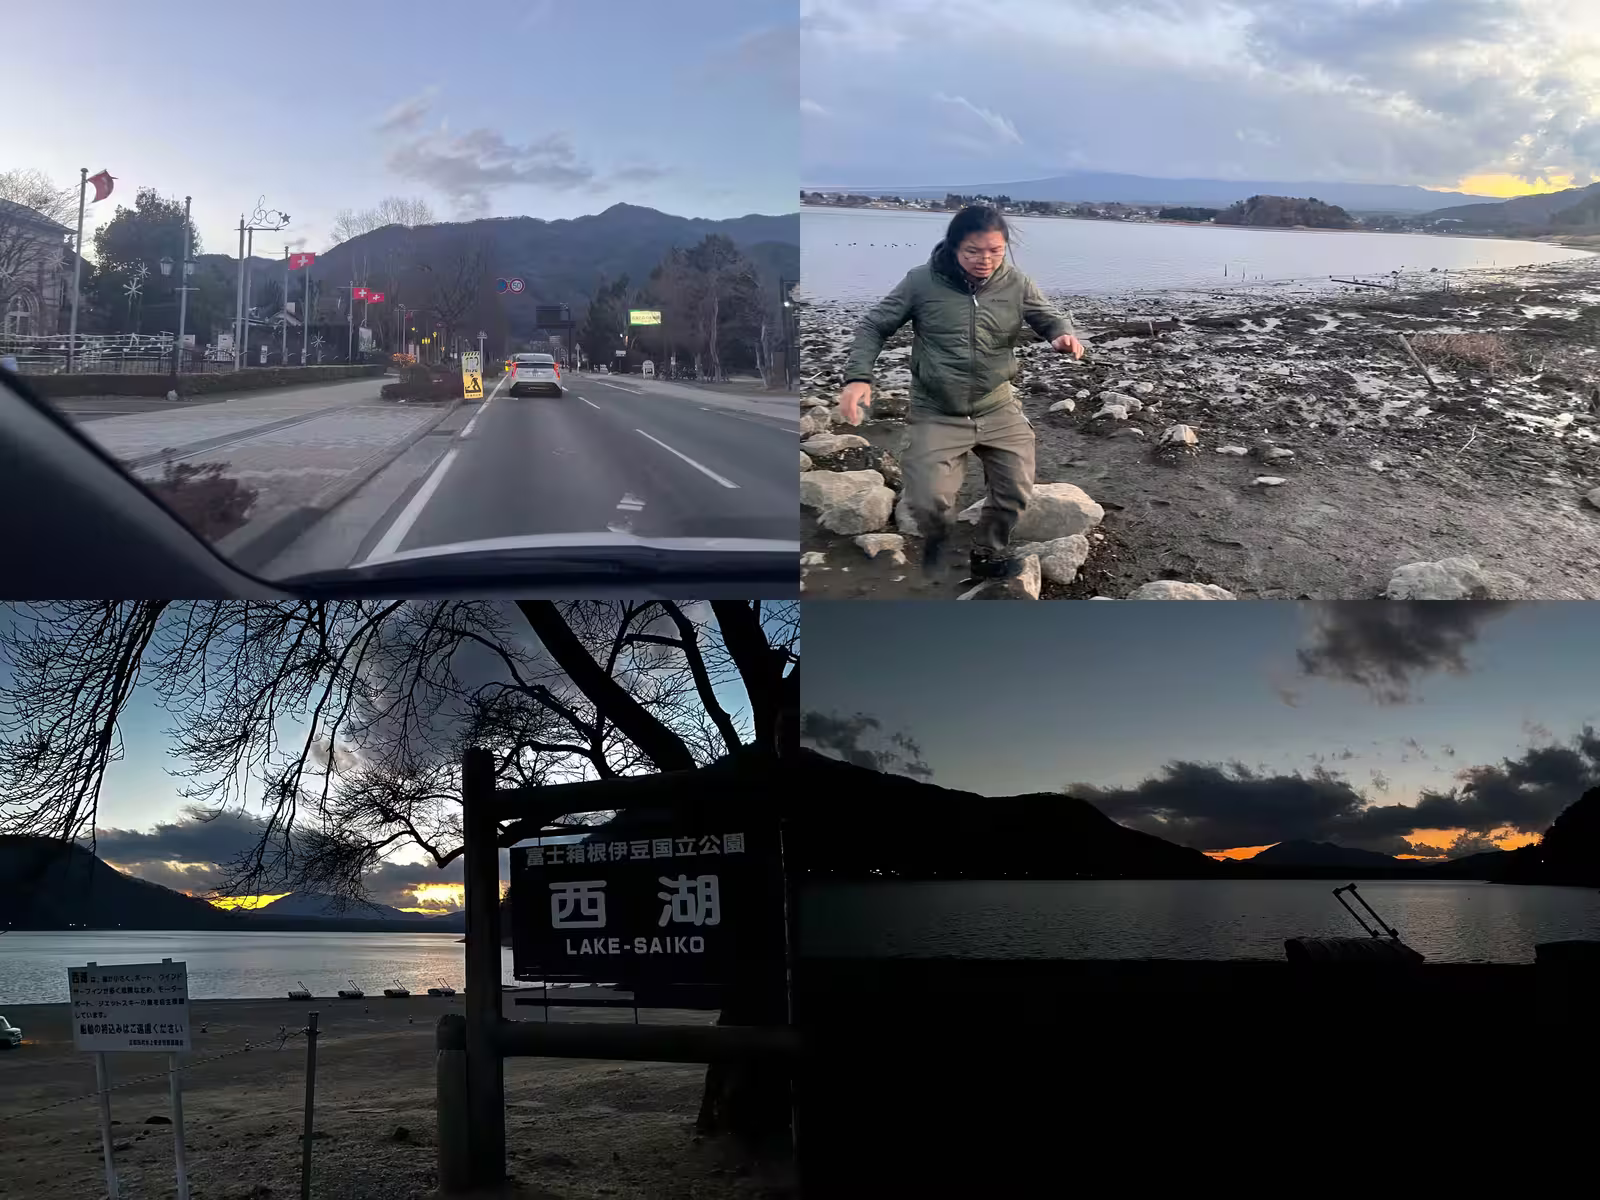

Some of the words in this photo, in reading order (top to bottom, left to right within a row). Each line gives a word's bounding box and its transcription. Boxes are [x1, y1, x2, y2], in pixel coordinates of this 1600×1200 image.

[526, 832, 745, 866] 富士箱根伊豆国立公園
[566, 936, 705, 955] LAKE-SAIKO
